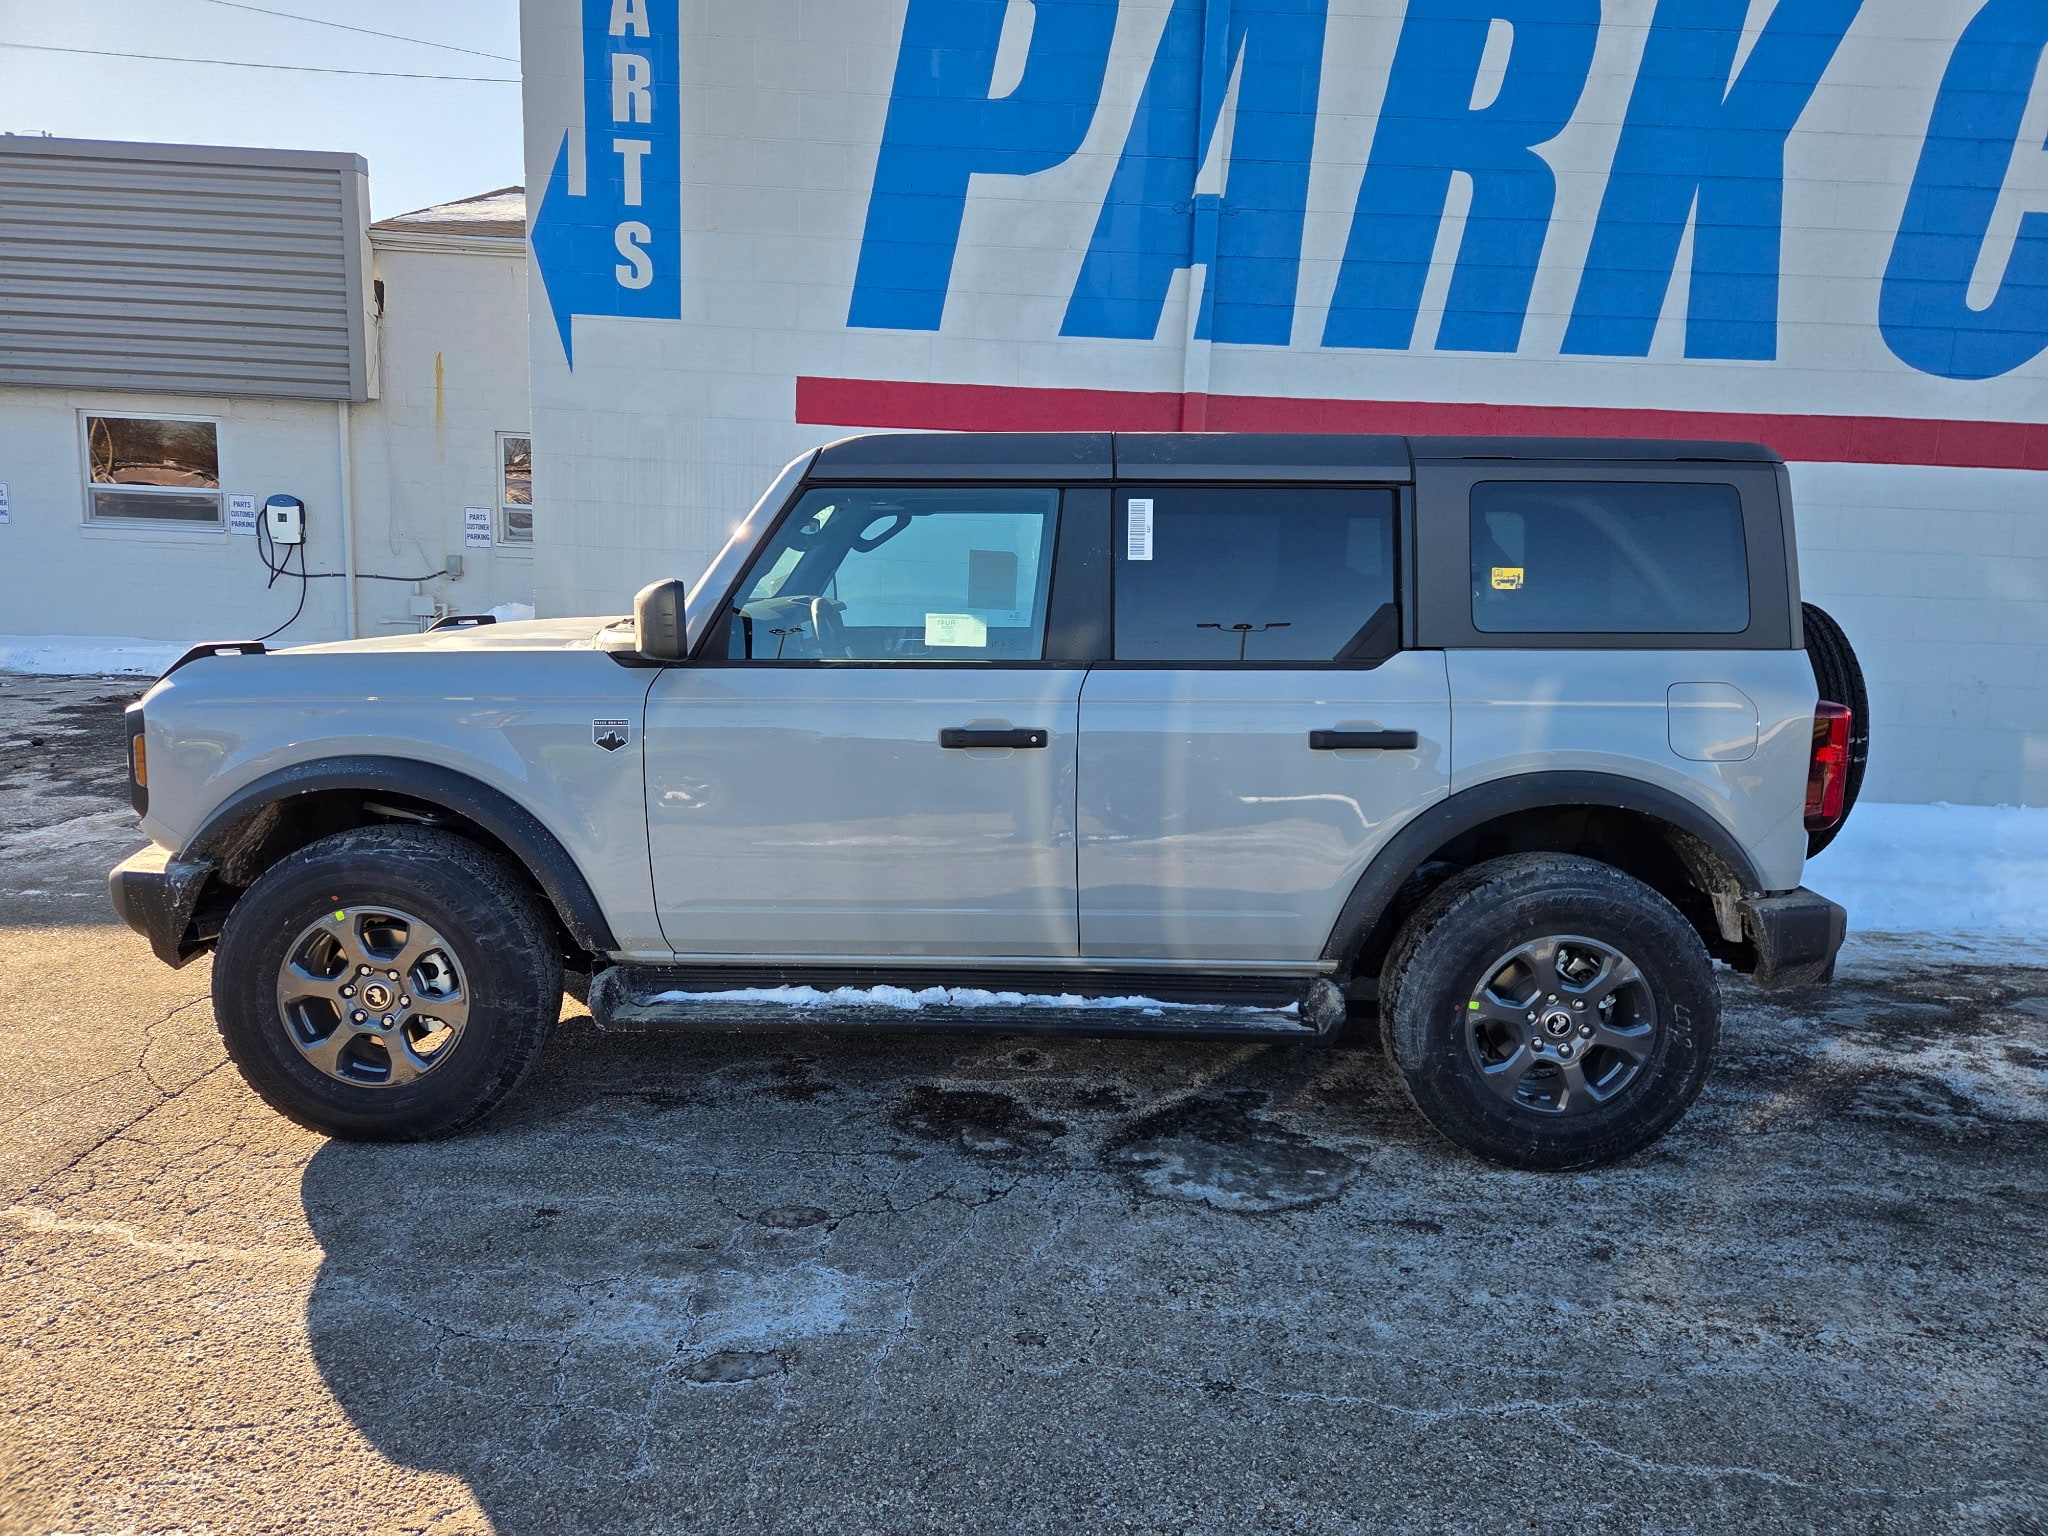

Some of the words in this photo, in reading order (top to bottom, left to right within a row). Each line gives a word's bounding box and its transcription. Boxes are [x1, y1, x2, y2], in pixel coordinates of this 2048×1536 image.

[846, 0, 1864, 361] PARK
[233, 500, 251, 508] PARTS
[231, 510, 254, 518] CUSTOMER
[469, 513, 487, 521] PARTS
[231, 520, 255, 528] PARKING
[466, 523, 489, 531] CUSTOMER
[466, 533, 490, 541] PARKING
